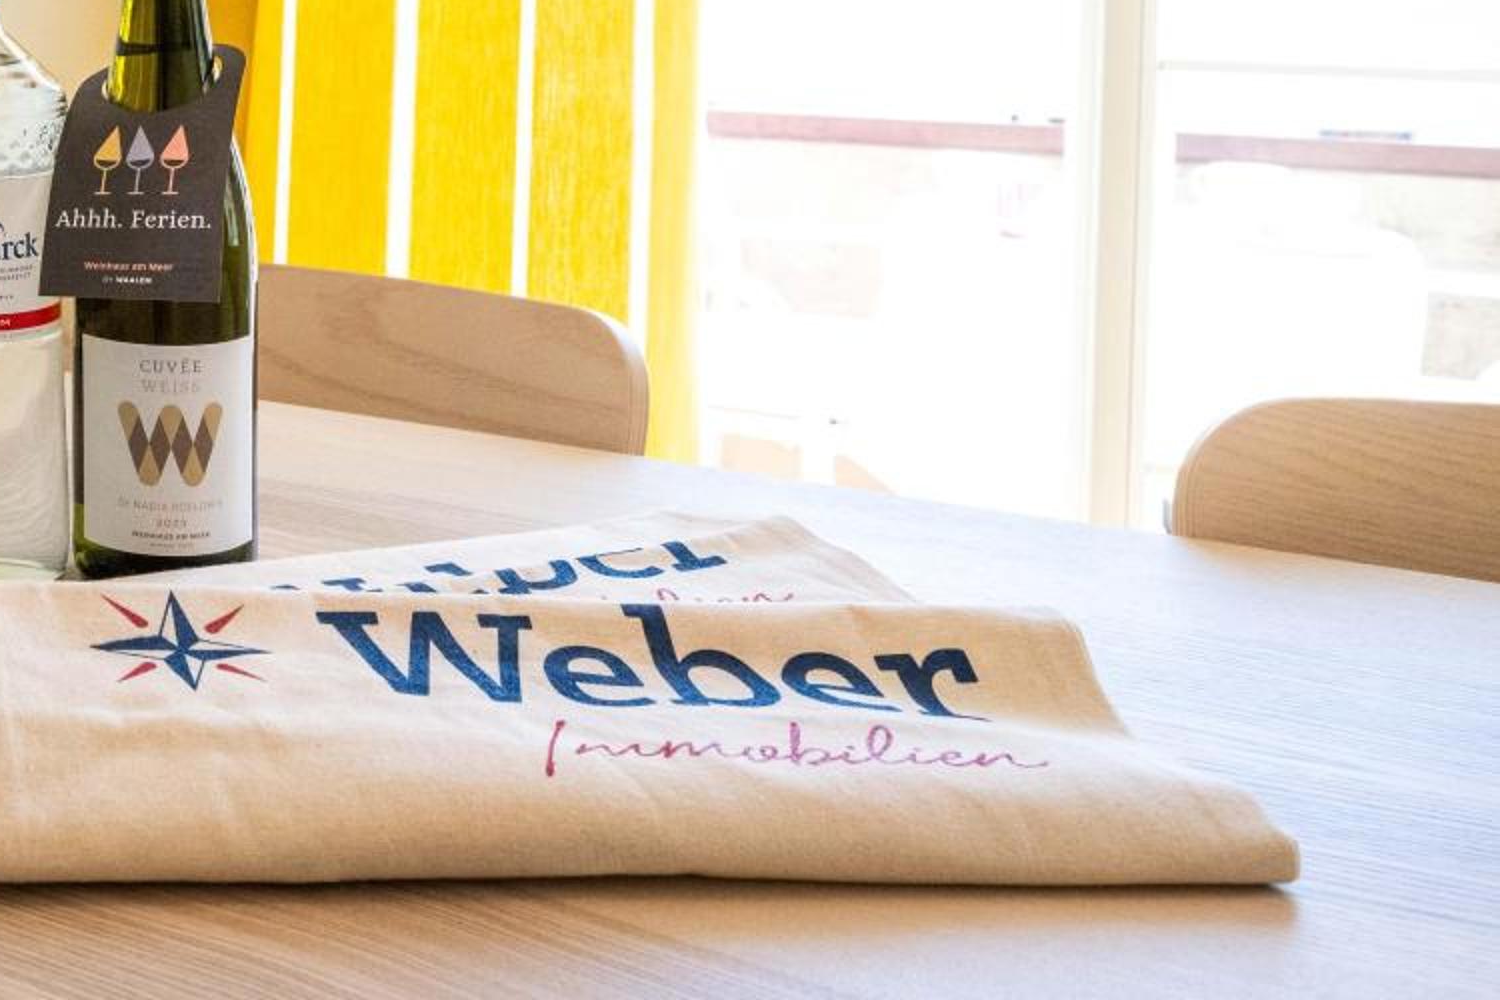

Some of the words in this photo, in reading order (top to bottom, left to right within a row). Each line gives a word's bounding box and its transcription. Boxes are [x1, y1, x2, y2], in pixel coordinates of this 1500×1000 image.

[55, 207, 123, 228] Ahhh.
[130, 208, 212, 229] Ferien.
[139, 358, 203, 373] CUVÉE
[141, 379, 201, 393] WEISS
[315, 602, 992, 722] Weber
[545, 719, 1049, 777] Immobilien
